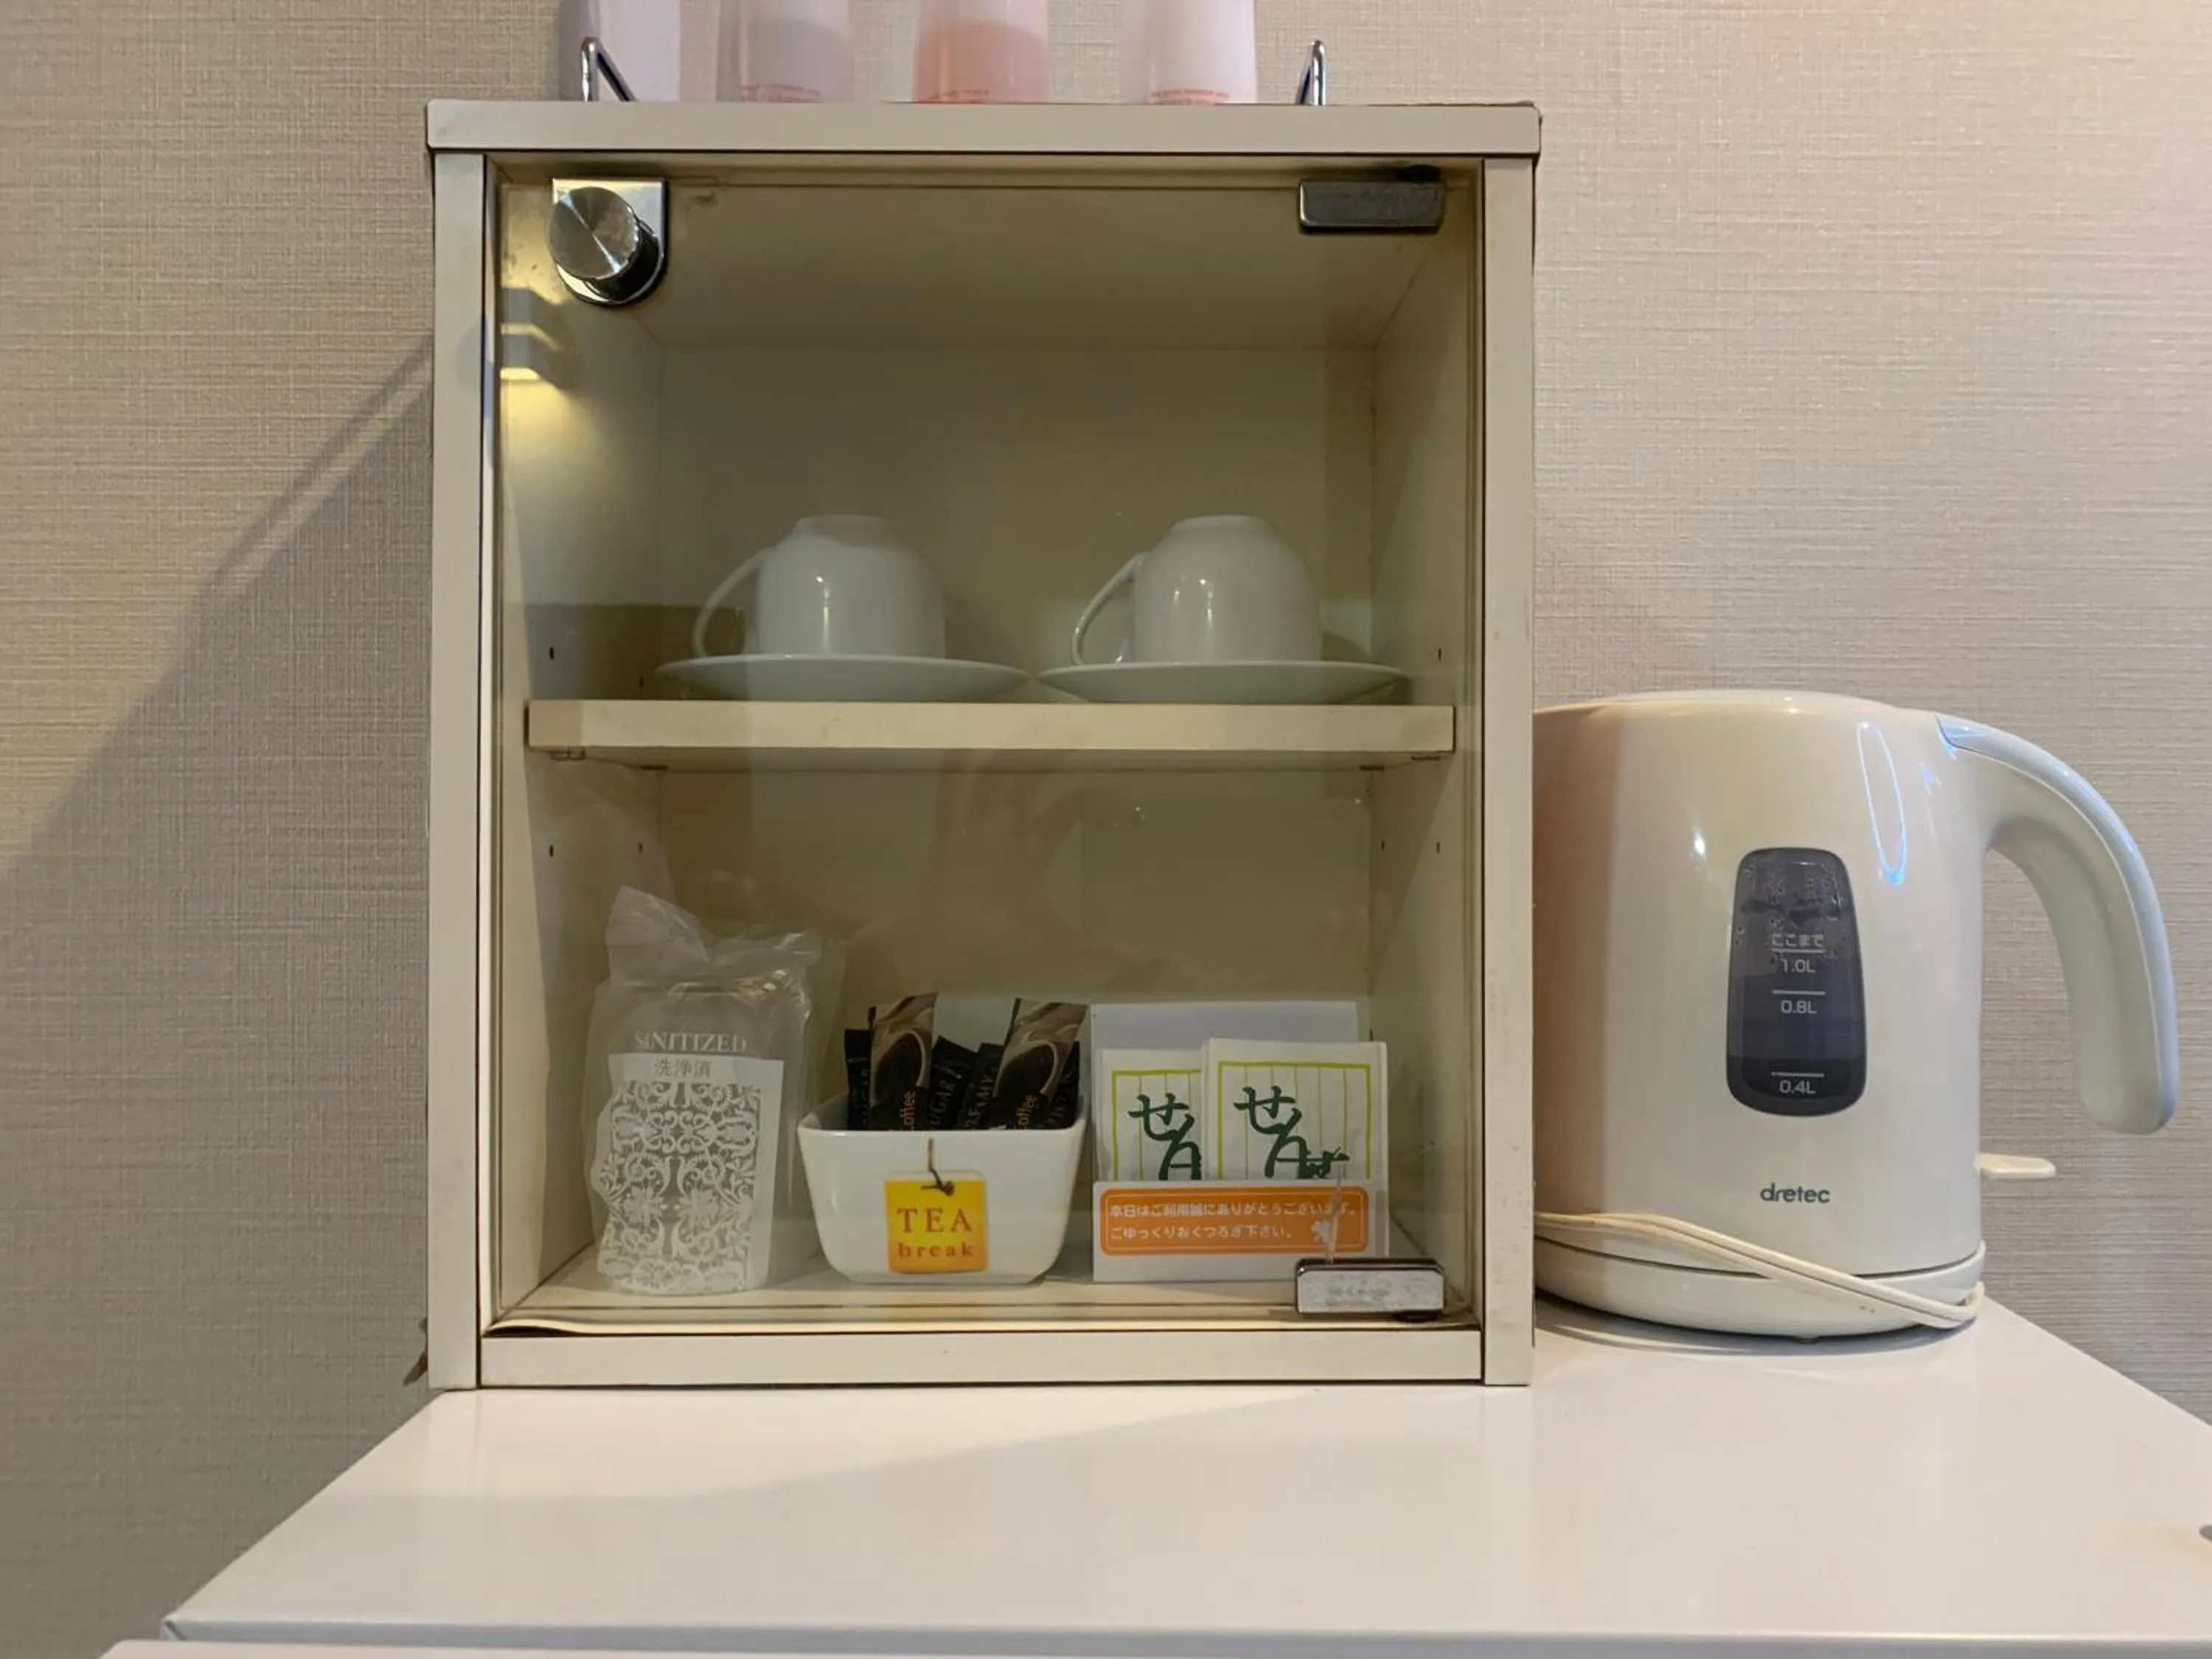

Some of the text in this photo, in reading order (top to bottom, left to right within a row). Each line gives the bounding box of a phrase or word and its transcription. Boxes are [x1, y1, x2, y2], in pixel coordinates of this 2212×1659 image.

[1772, 933, 1823, 947] ここまで
[1781, 959, 1816, 973] 1.0L
[1781, 1000, 1817, 1014] 0.8L
[1779, 1079, 1816, 1095] 0.4L
[899, 1091, 917, 1130] offee
[1015, 1093, 1038, 1130] offee
[1760, 1181, 1830, 1203] dretec
[896, 1206, 973, 1234] TEA
[897, 1241, 974, 1259] break
